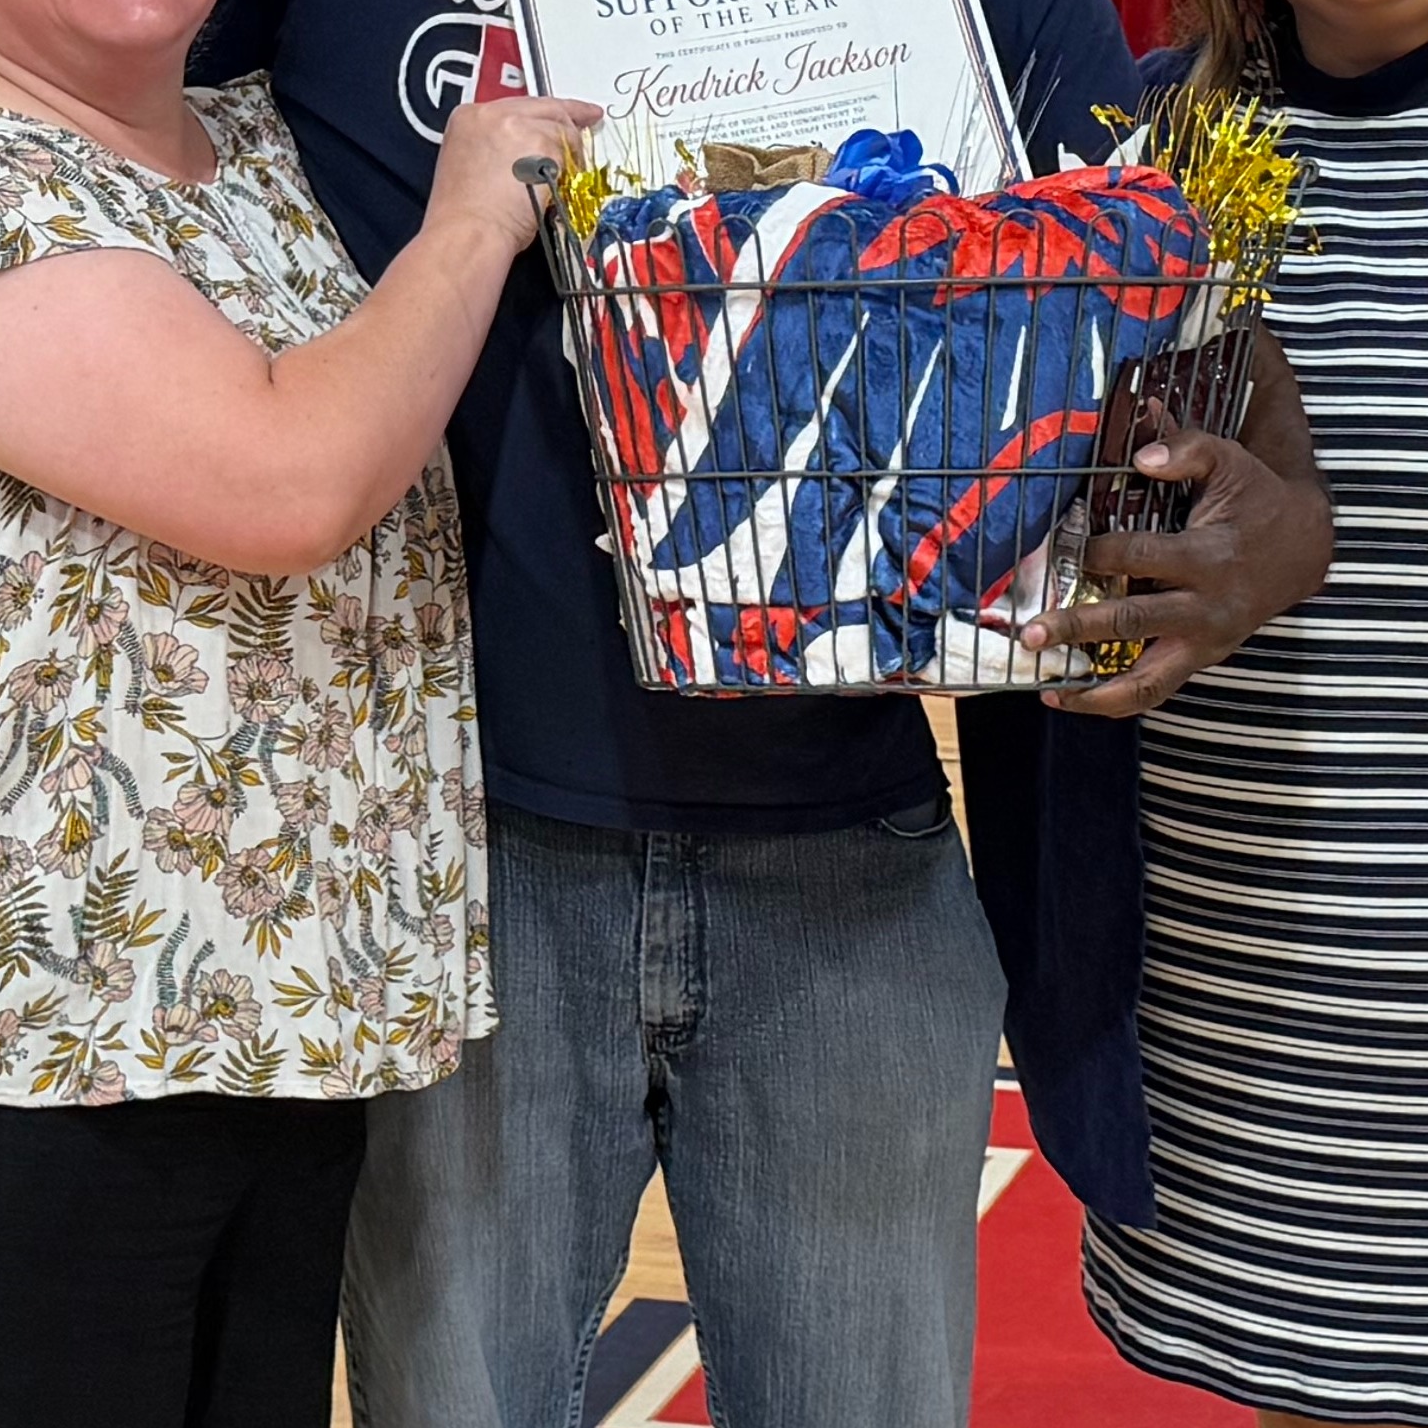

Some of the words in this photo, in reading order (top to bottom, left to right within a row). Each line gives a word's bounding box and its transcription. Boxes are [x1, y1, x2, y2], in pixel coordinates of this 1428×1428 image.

[650, 16, 684, 37] OF
[697, 6, 753, 29] THE
[607, 58, 769, 119] Kendrick
[772, 41, 913, 95] Jackson
